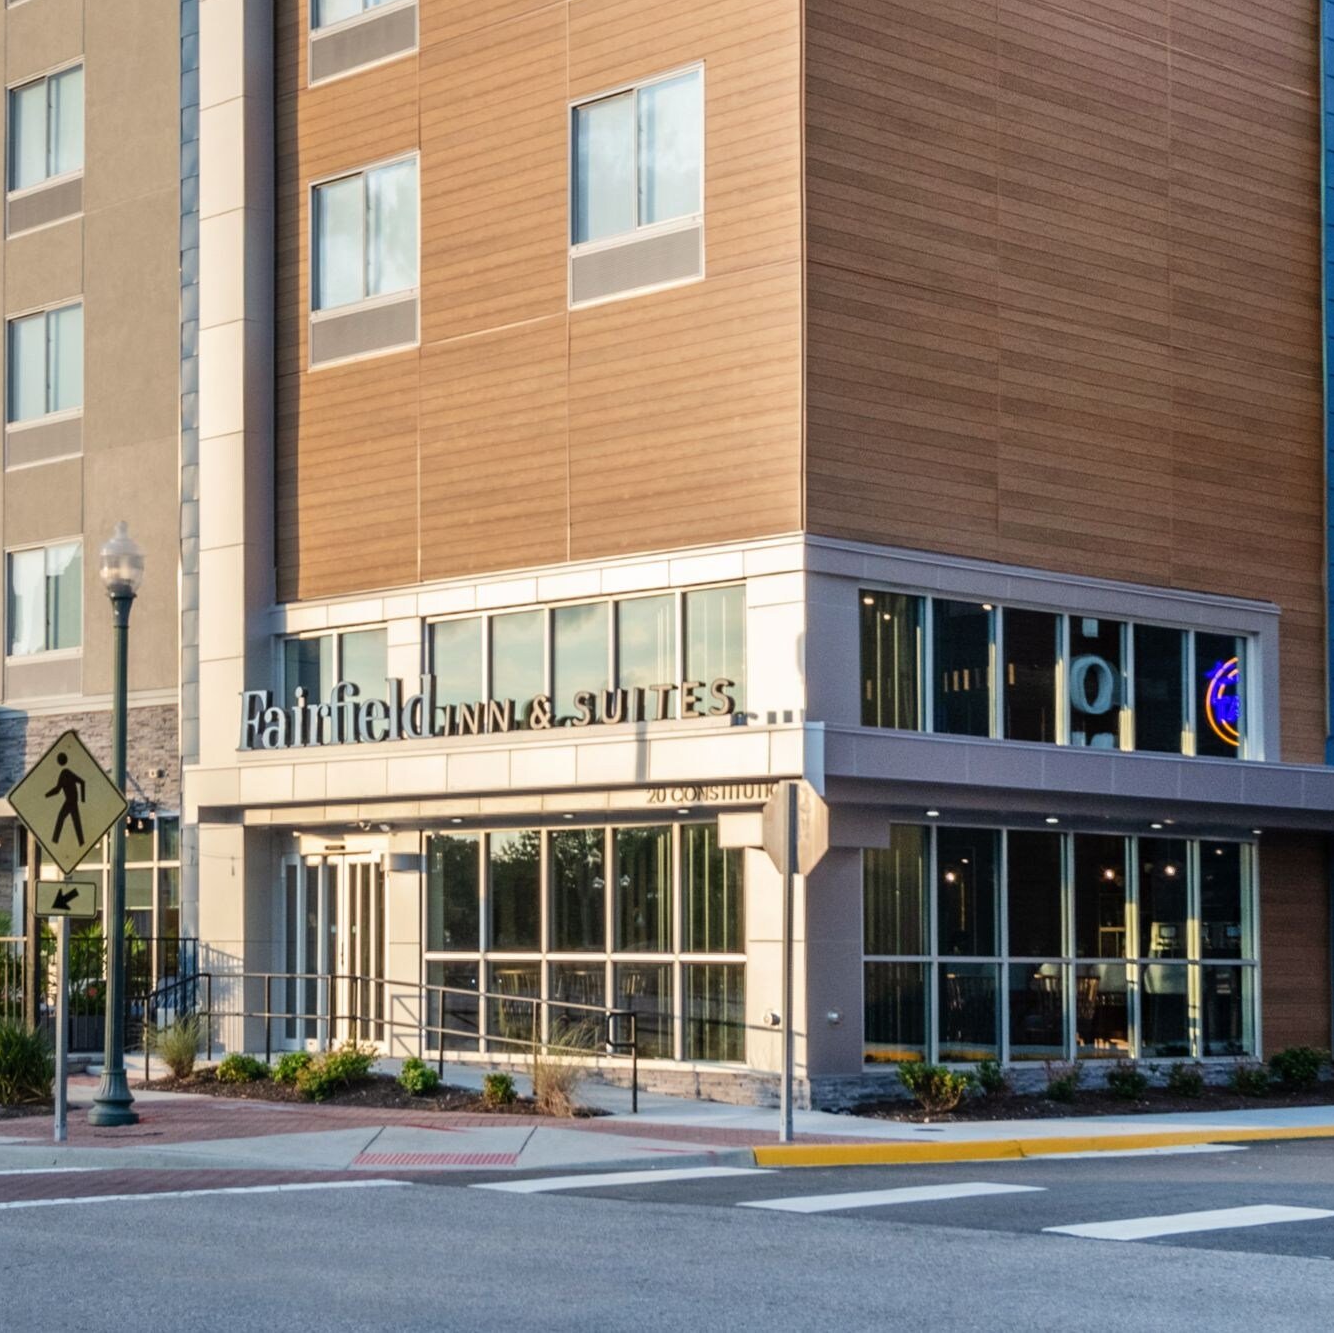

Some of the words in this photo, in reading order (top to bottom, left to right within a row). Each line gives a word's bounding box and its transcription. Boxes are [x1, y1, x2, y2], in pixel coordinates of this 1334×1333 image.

[235, 673, 437, 752] Fairfield
[442, 697, 516, 737] INN
[528, 693, 554, 730] &
[572, 677, 737, 726] SUITES
[646, 787, 667, 804] 20
